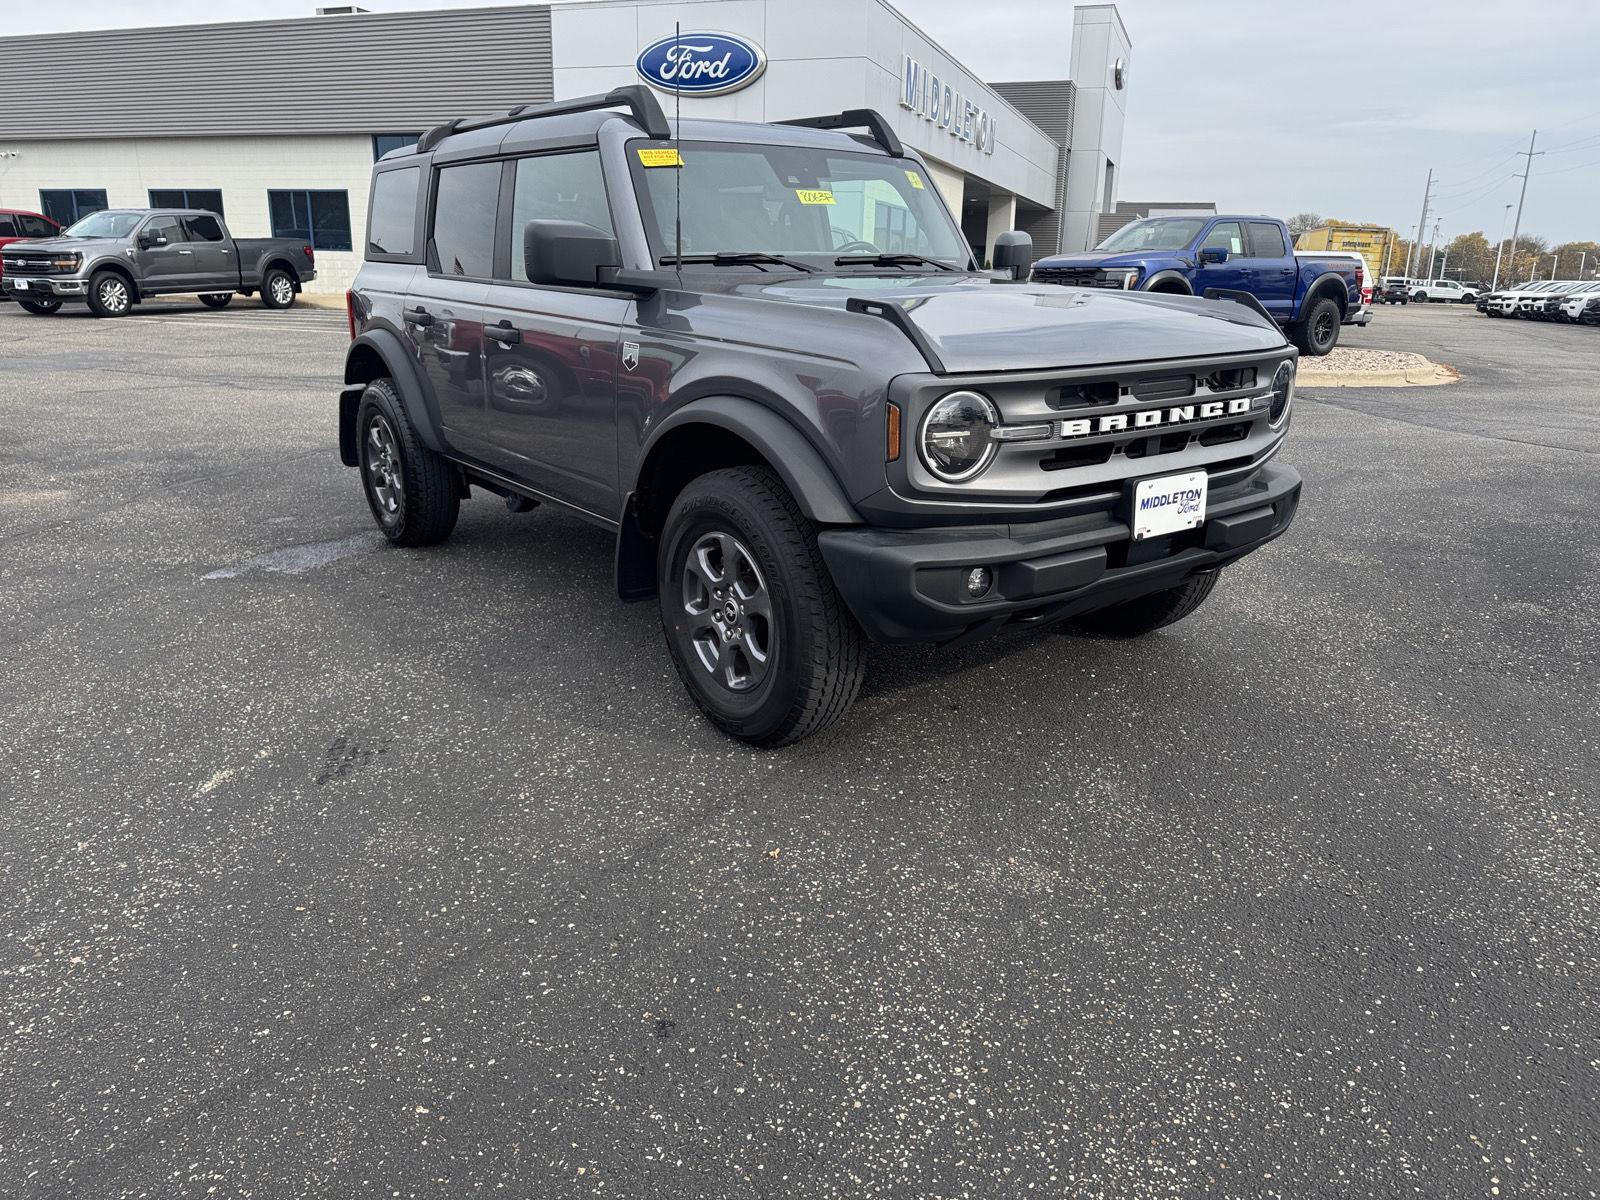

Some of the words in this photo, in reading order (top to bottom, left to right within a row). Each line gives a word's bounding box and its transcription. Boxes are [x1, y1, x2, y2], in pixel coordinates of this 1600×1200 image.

[660, 45, 732, 80] Ford
[901, 54, 996, 155] MIDDLETON
[1061, 398, 1250, 437] BRONCO
[1140, 488, 1203, 511] MIDDLETON
[1177, 498, 1201, 515] Ford
